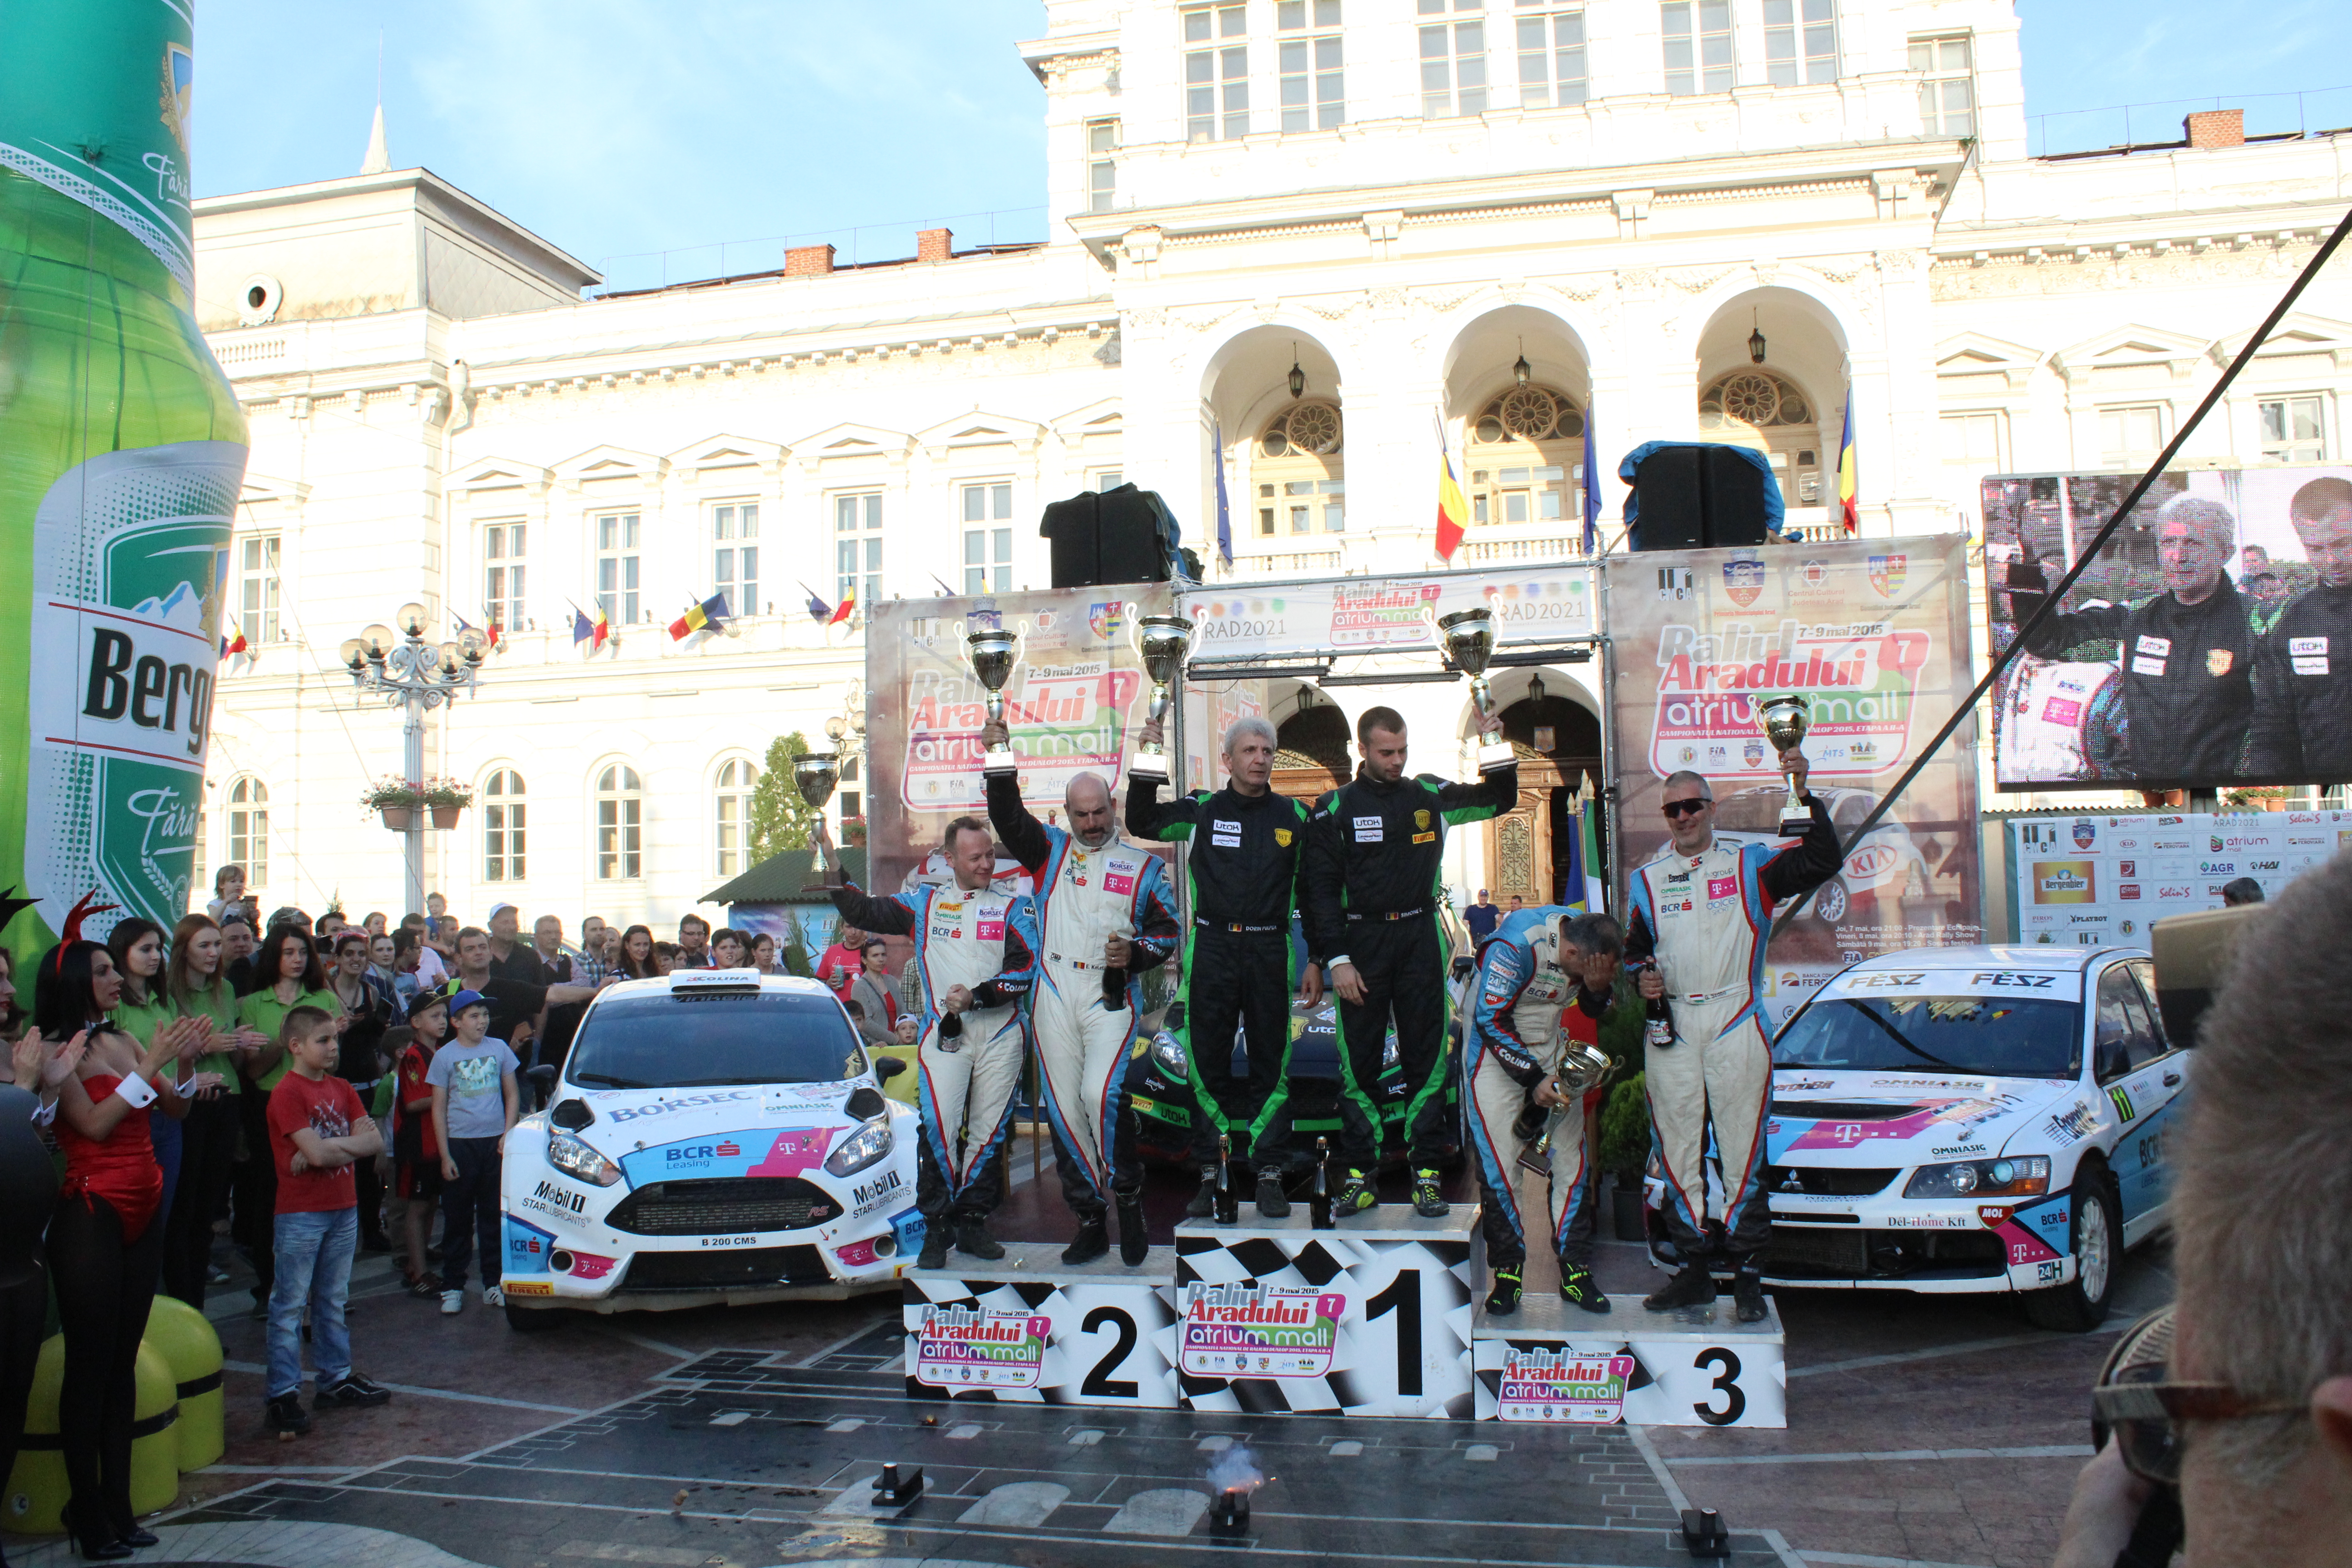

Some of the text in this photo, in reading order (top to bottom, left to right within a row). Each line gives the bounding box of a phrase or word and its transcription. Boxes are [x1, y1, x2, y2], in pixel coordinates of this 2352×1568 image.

[1333, 581, 1388, 600] Raliul
[1658, 588, 1692, 601] CMCA
[1333, 591, 1417, 611] Aradului
[1800, 625, 1883, 638] 7 9 mai 2015
[913, 637, 941, 647] CMCA
[1660, 622, 1797, 663] Raliul
[1898, 640, 1911, 664] 7
[1029, 664, 1100, 678] 7 9 mai 2015
[1660, 648, 1867, 691] Aradului
[1114, 679, 1125, 700] 7
[1667, 690, 1897, 726] atriu mall
[2226, 837, 2269, 846] atrium
[1109, 862, 1134, 871] BORSEC
[1853, 846, 1896, 875] KIA
[2210, 863, 2234, 872] AGR
[2045, 880, 2084, 890] Bergenbier
[2121, 885, 2139, 893] glasul
[1661, 903, 1681, 913] BCR
[1706, 897, 1736, 910] dolce
[1401, 909, 1419, 917] SIMONE
[932, 927, 950, 937] BCR
[1004, 983, 1028, 992] COLINA
[1527, 987, 1548, 998] BCR
[1498, 1049, 1531, 1069] COLINA
[1873, 1079, 1985, 1088] OMNIASIG
[765, 1102, 834, 1111] OMNIASIG
[1990, 1093, 2024, 1106] 11
[2112, 1087, 2133, 1121] 11
[608, 1091, 752, 1123] BORSEC
[1835, 1124, 1861, 1143] T
[666, 1147, 714, 1161] BCR
[1931, 1144, 1986, 1155] OMNIASIG
[666, 1159, 710, 1170] Leasing
[534, 1181, 572, 1208] Mobil
[853, 1176, 889, 1205] Mobil
[808, 1205, 830, 1217] RS
[1982, 1208, 2003, 1218] MOL
[1888, 1216, 1966, 1227] Dél-Home Kft
[2041, 1214, 2058, 1225] BCR
[734, 1236, 756, 1245] CMS
[507, 1284, 550, 1295] PIRELLI
[1186, 1282, 1268, 1306] Raliul
[1186, 1299, 1310, 1324] Aradului
[1327, 1298, 1336, 1313] 7
[921, 1305, 987, 1325] Raliul
[921, 1319, 1022, 1342] Aradului
[1035, 1319, 1043, 1333] 7
[1366, 1269, 1423, 1396] 1
[1191, 1325, 1328, 1347] atrium mall
[923, 1342, 1036, 1362] atrium mall
[1080, 1306, 1139, 1398] 2
[1503, 1349, 1570, 1367] Raliul
[1502, 1362, 1603, 1381] Aradului
[1618, 1360, 1625, 1372] 7
[1505, 1383, 1618, 1399] atrium mall
[1693, 1347, 1746, 1426] 3
